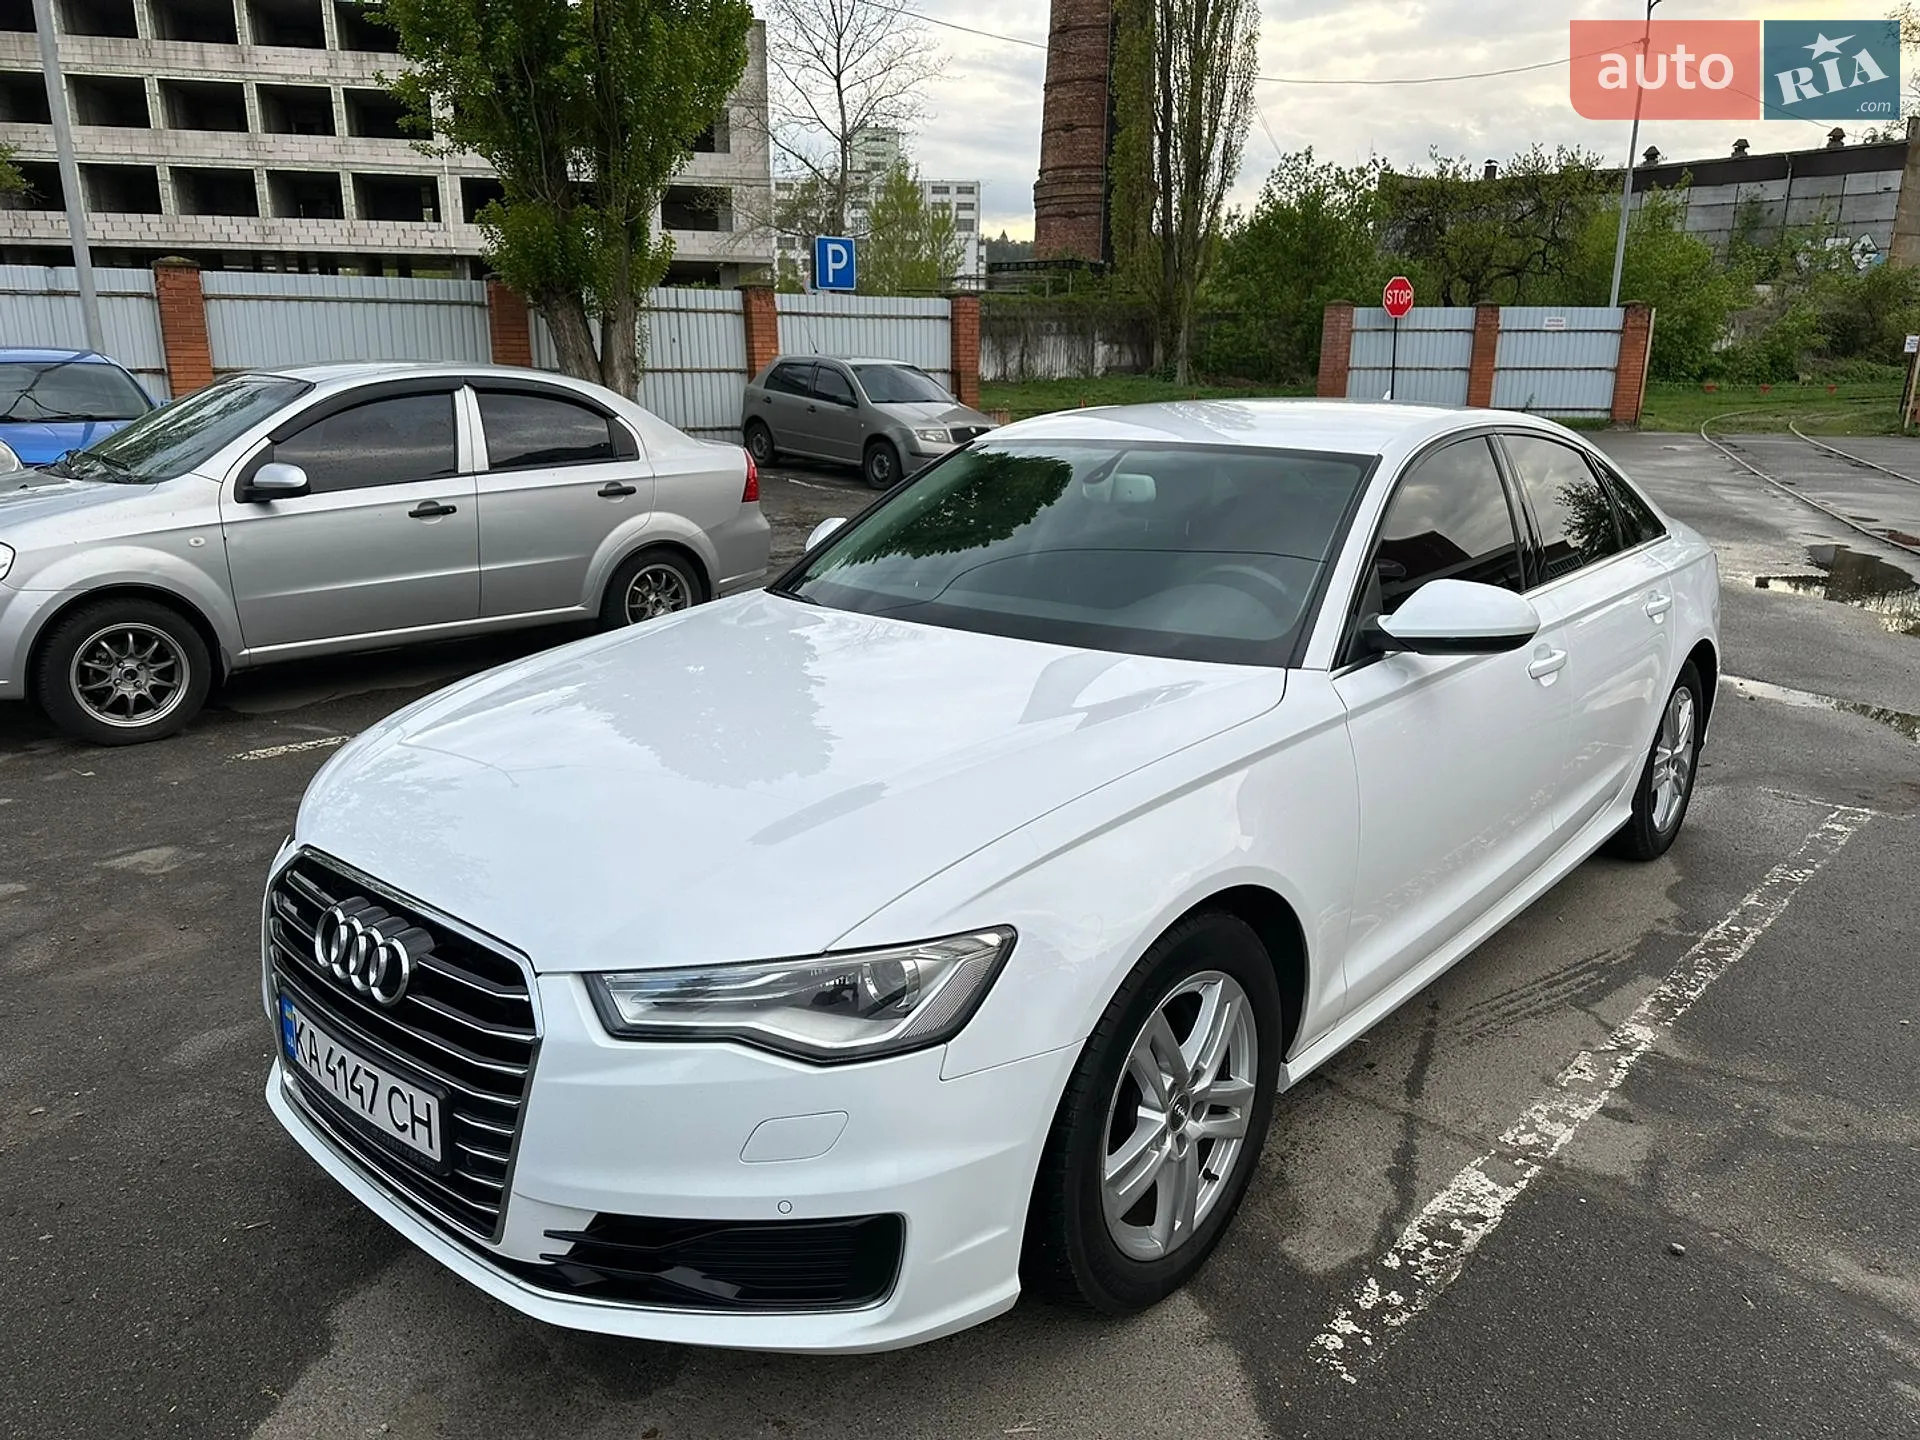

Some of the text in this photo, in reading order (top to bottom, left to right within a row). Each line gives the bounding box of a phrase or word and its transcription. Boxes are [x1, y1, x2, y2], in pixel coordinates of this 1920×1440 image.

[826, 243, 848, 283] P
[1386, 290, 1411, 305] STOP
[293, 1013, 323, 1078] KA
[325, 1046, 379, 1115] 4147
[388, 1085, 434, 1151] CH
